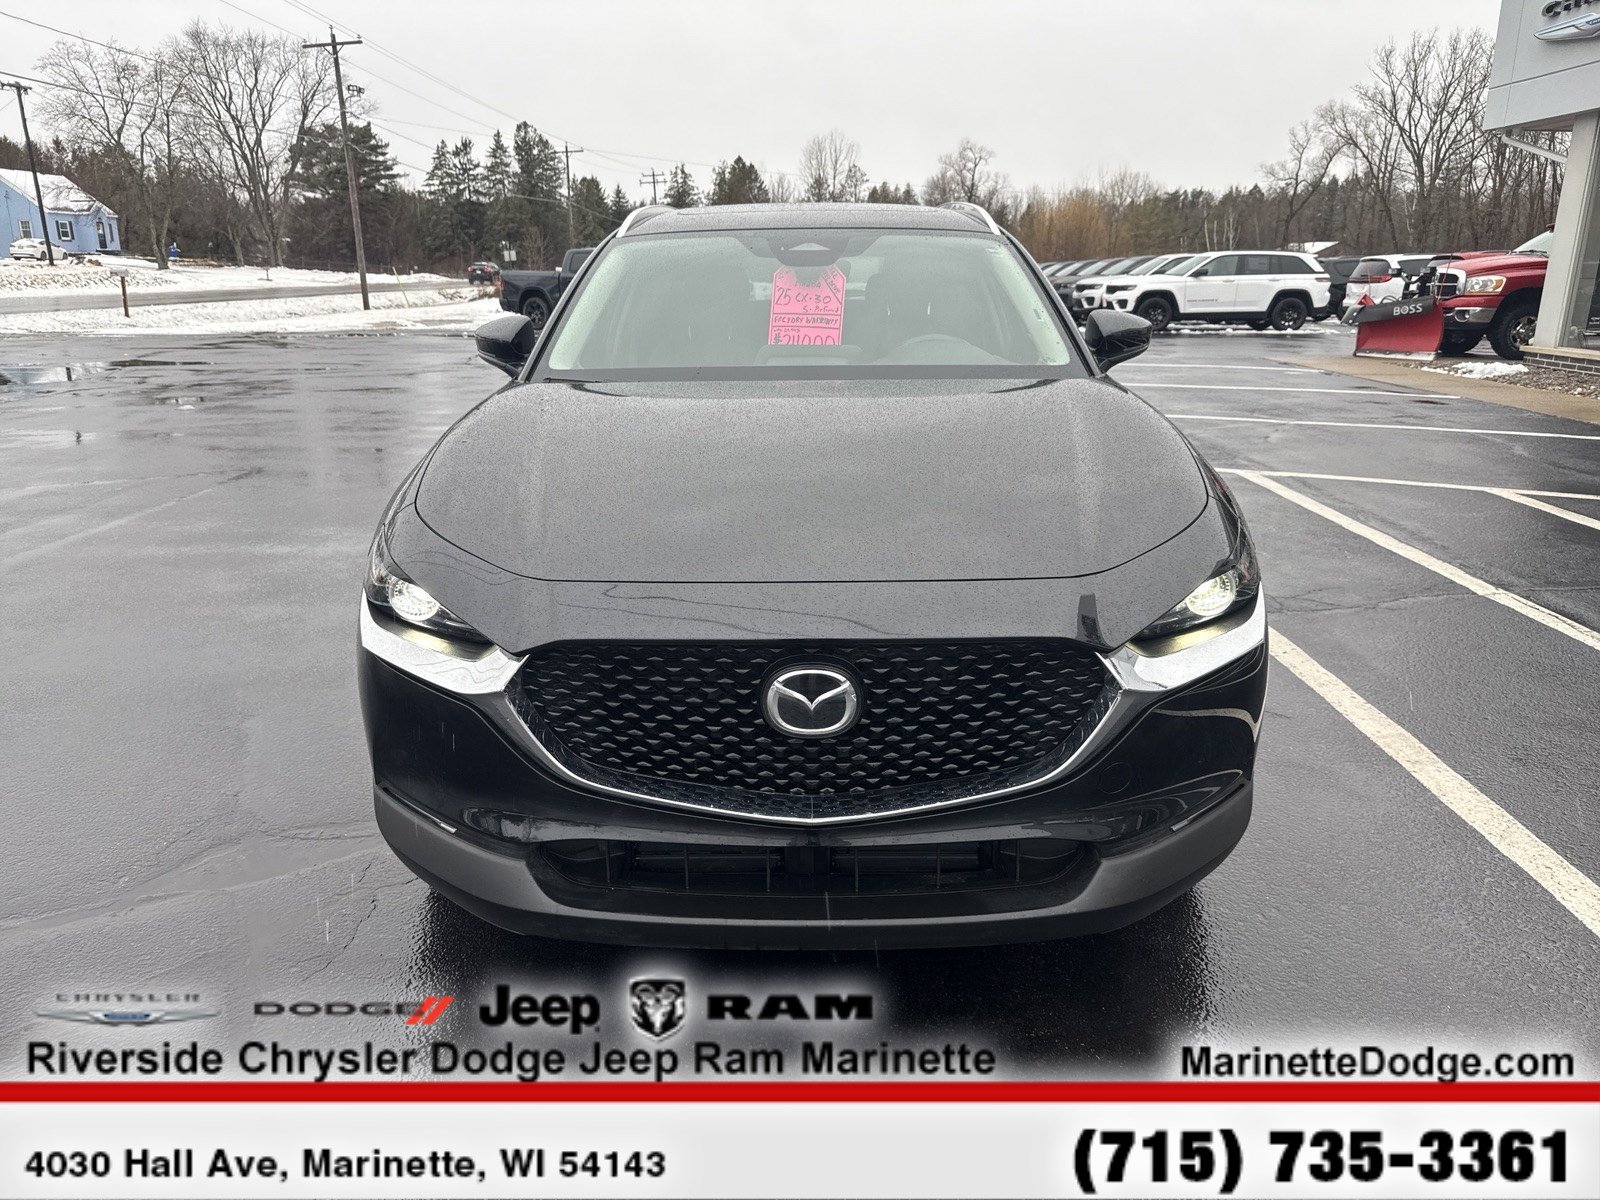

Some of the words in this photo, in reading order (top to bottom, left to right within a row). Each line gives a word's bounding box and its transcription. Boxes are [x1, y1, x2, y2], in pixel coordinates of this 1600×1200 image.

[1393, 303, 1423, 316] BOSS
[774, 315, 804, 325] FACTORY
[805, 316, 840, 326] WARRANTY
